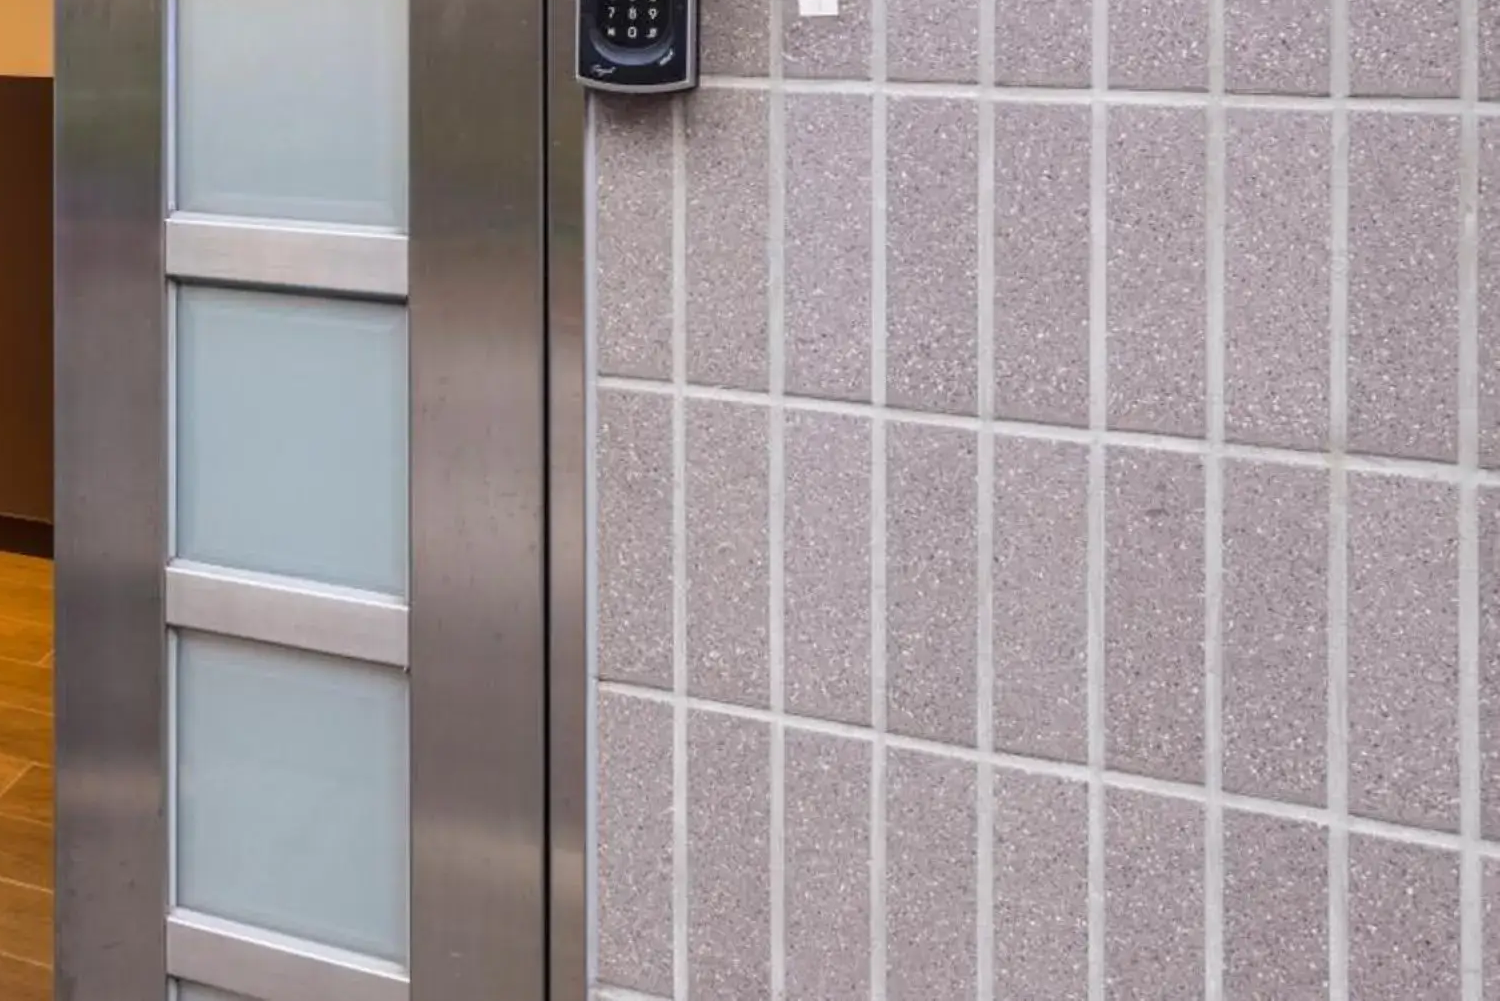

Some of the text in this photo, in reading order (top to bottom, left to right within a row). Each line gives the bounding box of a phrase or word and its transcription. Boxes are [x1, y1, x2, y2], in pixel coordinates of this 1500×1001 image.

[607, 5, 659, 20] 7 8 9
[627, 26, 638, 39] 0
